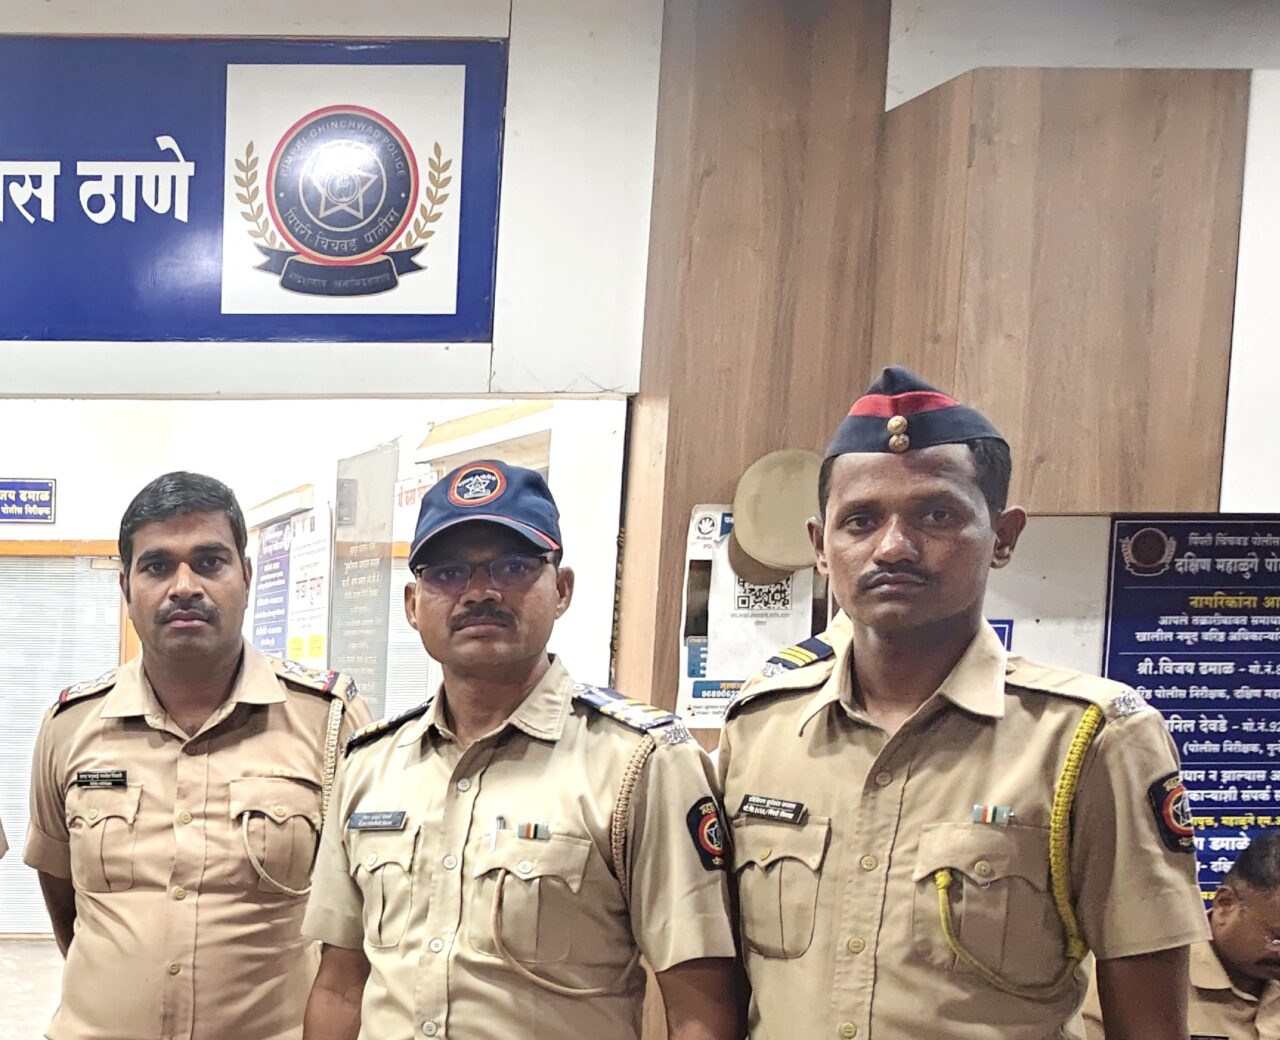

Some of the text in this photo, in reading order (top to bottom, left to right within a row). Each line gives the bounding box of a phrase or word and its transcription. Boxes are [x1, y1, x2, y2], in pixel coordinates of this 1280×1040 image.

[382, 136, 407, 178] POLICE
[77, 136, 195, 226] ठाणे
[1174, 552, 1212, 574] दक्षिण
[1135, 628, 1174, 642] खालील
